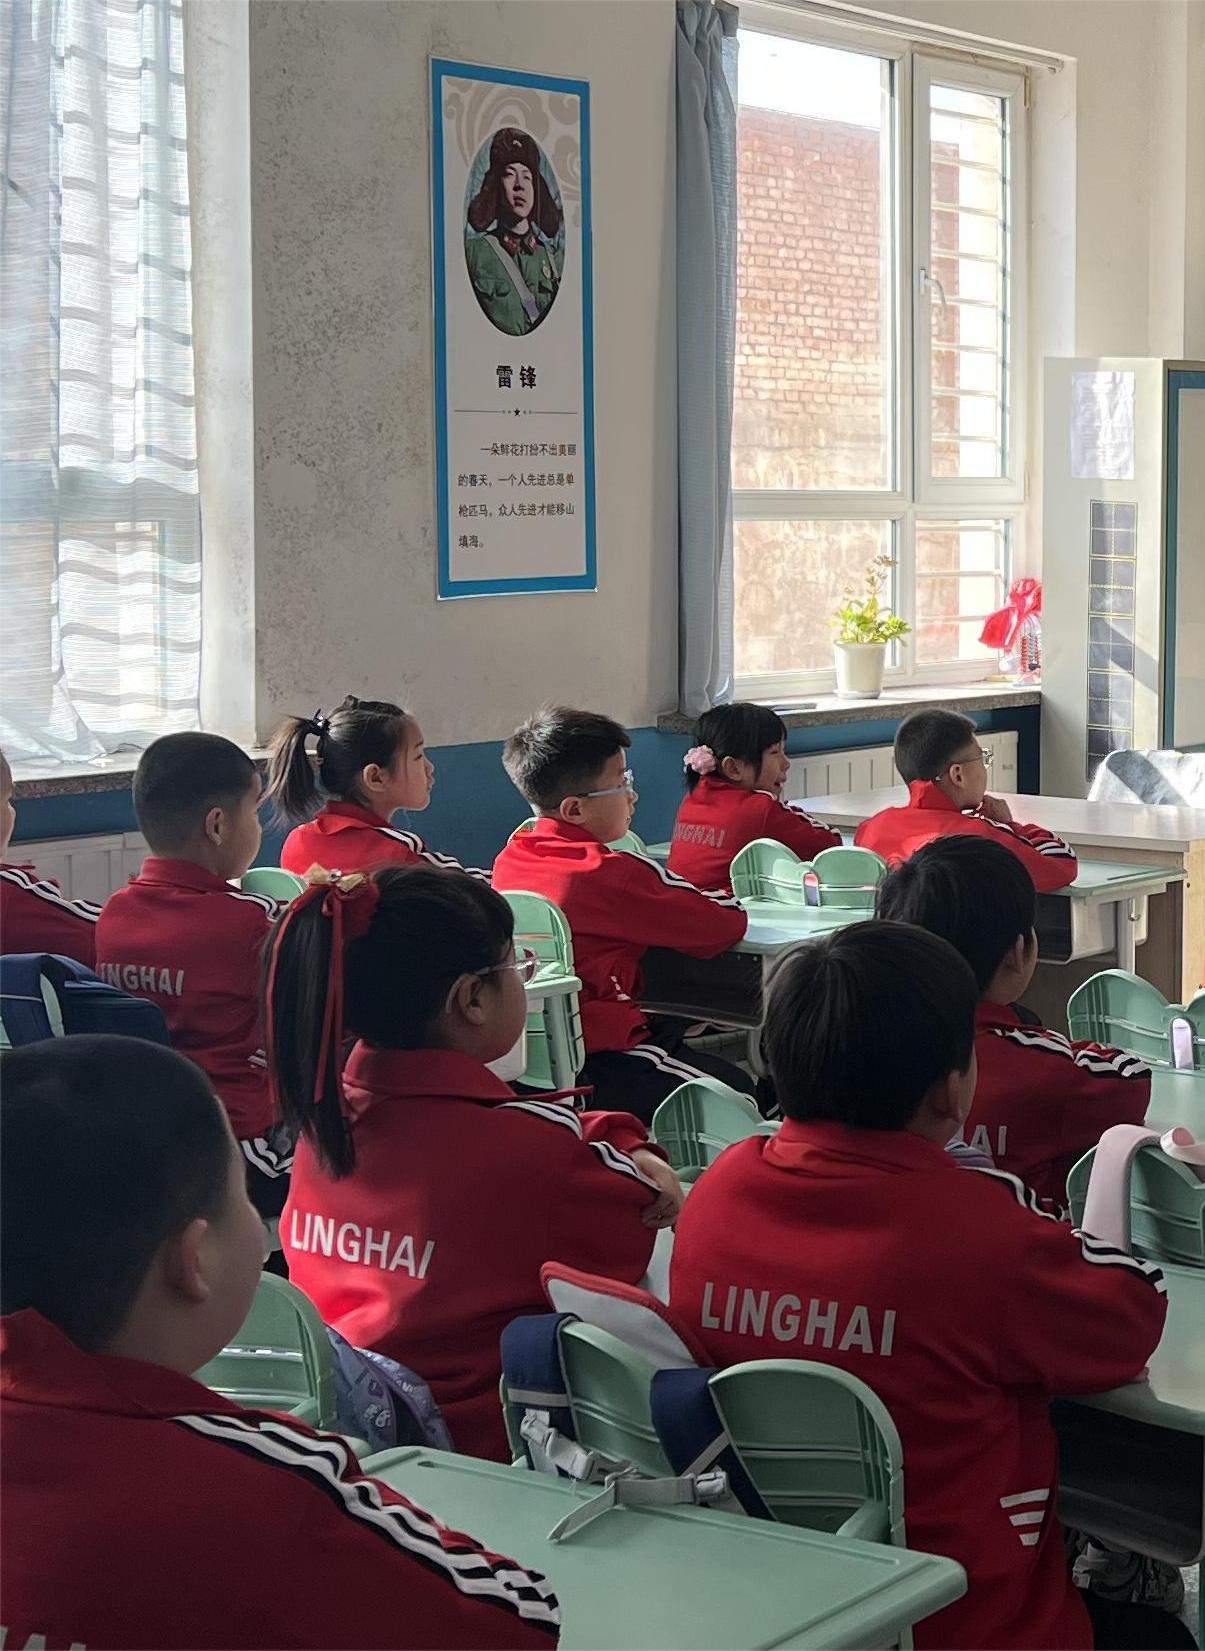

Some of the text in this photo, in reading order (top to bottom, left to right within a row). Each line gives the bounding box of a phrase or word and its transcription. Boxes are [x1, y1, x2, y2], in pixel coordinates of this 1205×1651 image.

[496, 365, 537, 389] 雷锋
[290, 1209, 436, 1280] LINGHAI
[701, 1282, 897, 1356] LINGHAI
